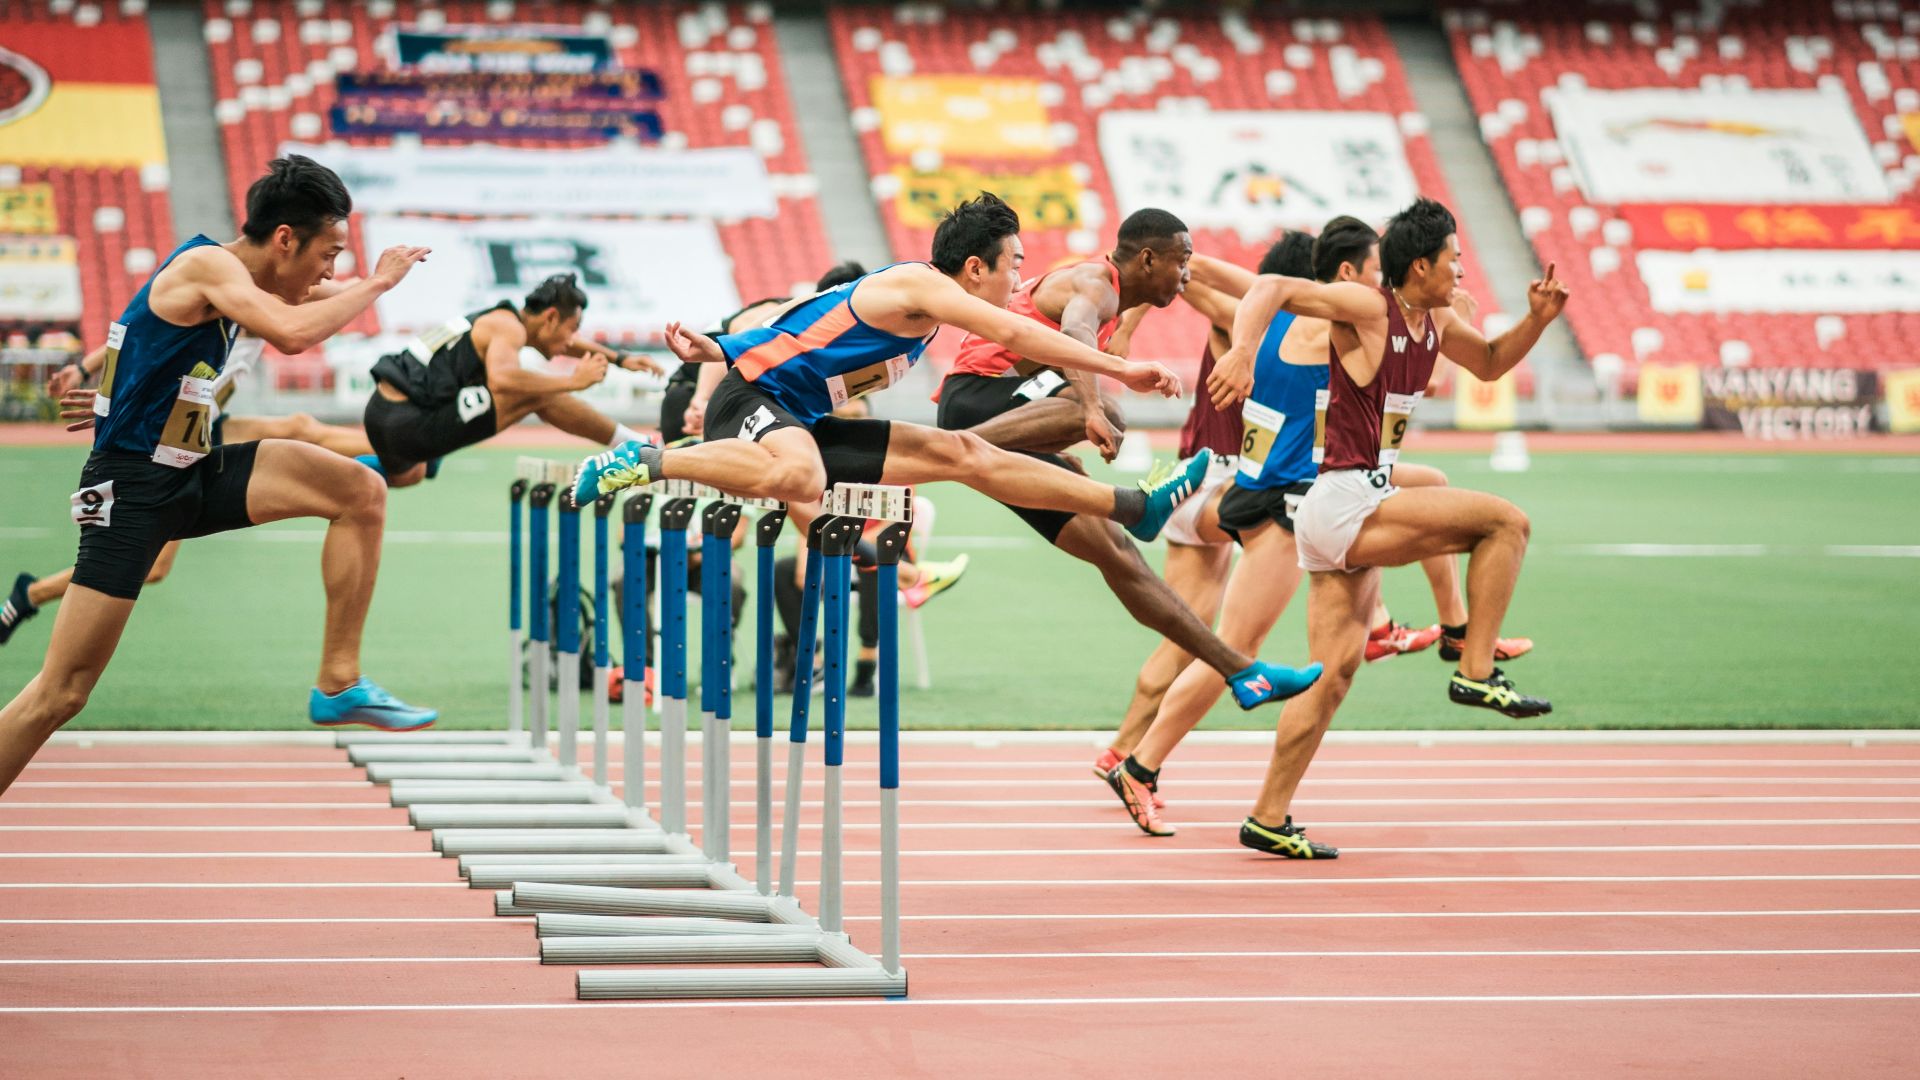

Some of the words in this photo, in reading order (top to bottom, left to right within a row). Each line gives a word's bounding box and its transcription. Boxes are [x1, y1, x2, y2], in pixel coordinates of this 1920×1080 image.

[1391, 335, 1408, 353] W
[1702, 368, 1857, 402] NANYANG
[1738, 404, 1872, 440] VICTORY
